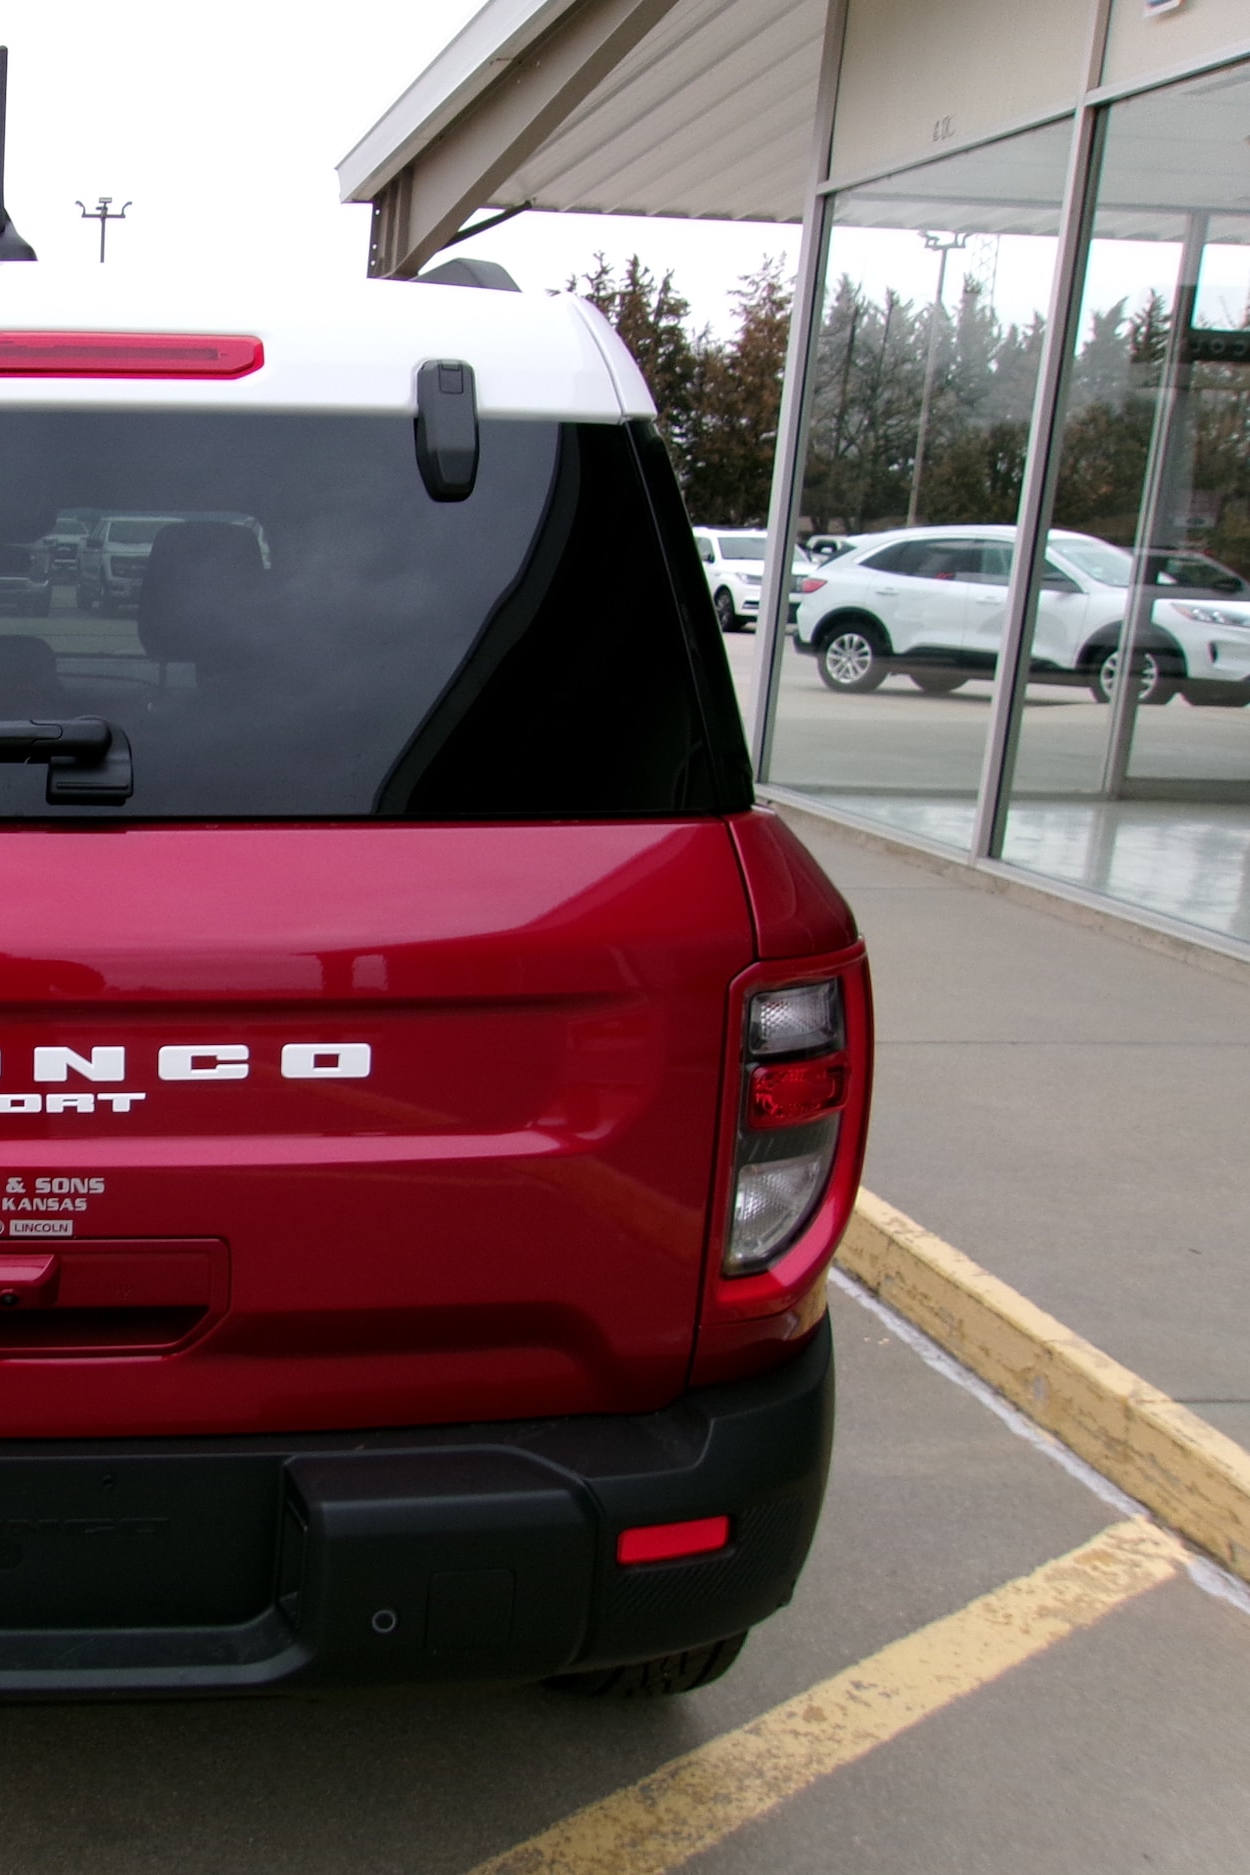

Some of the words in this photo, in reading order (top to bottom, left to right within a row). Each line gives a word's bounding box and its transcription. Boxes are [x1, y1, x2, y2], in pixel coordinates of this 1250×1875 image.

[5, 1177, 26, 1193] &
[35, 1177, 105, 1194] SONS
[1, 1197, 87, 1212] KANSAS
[13, 1222, 69, 1233] LINCOLN
